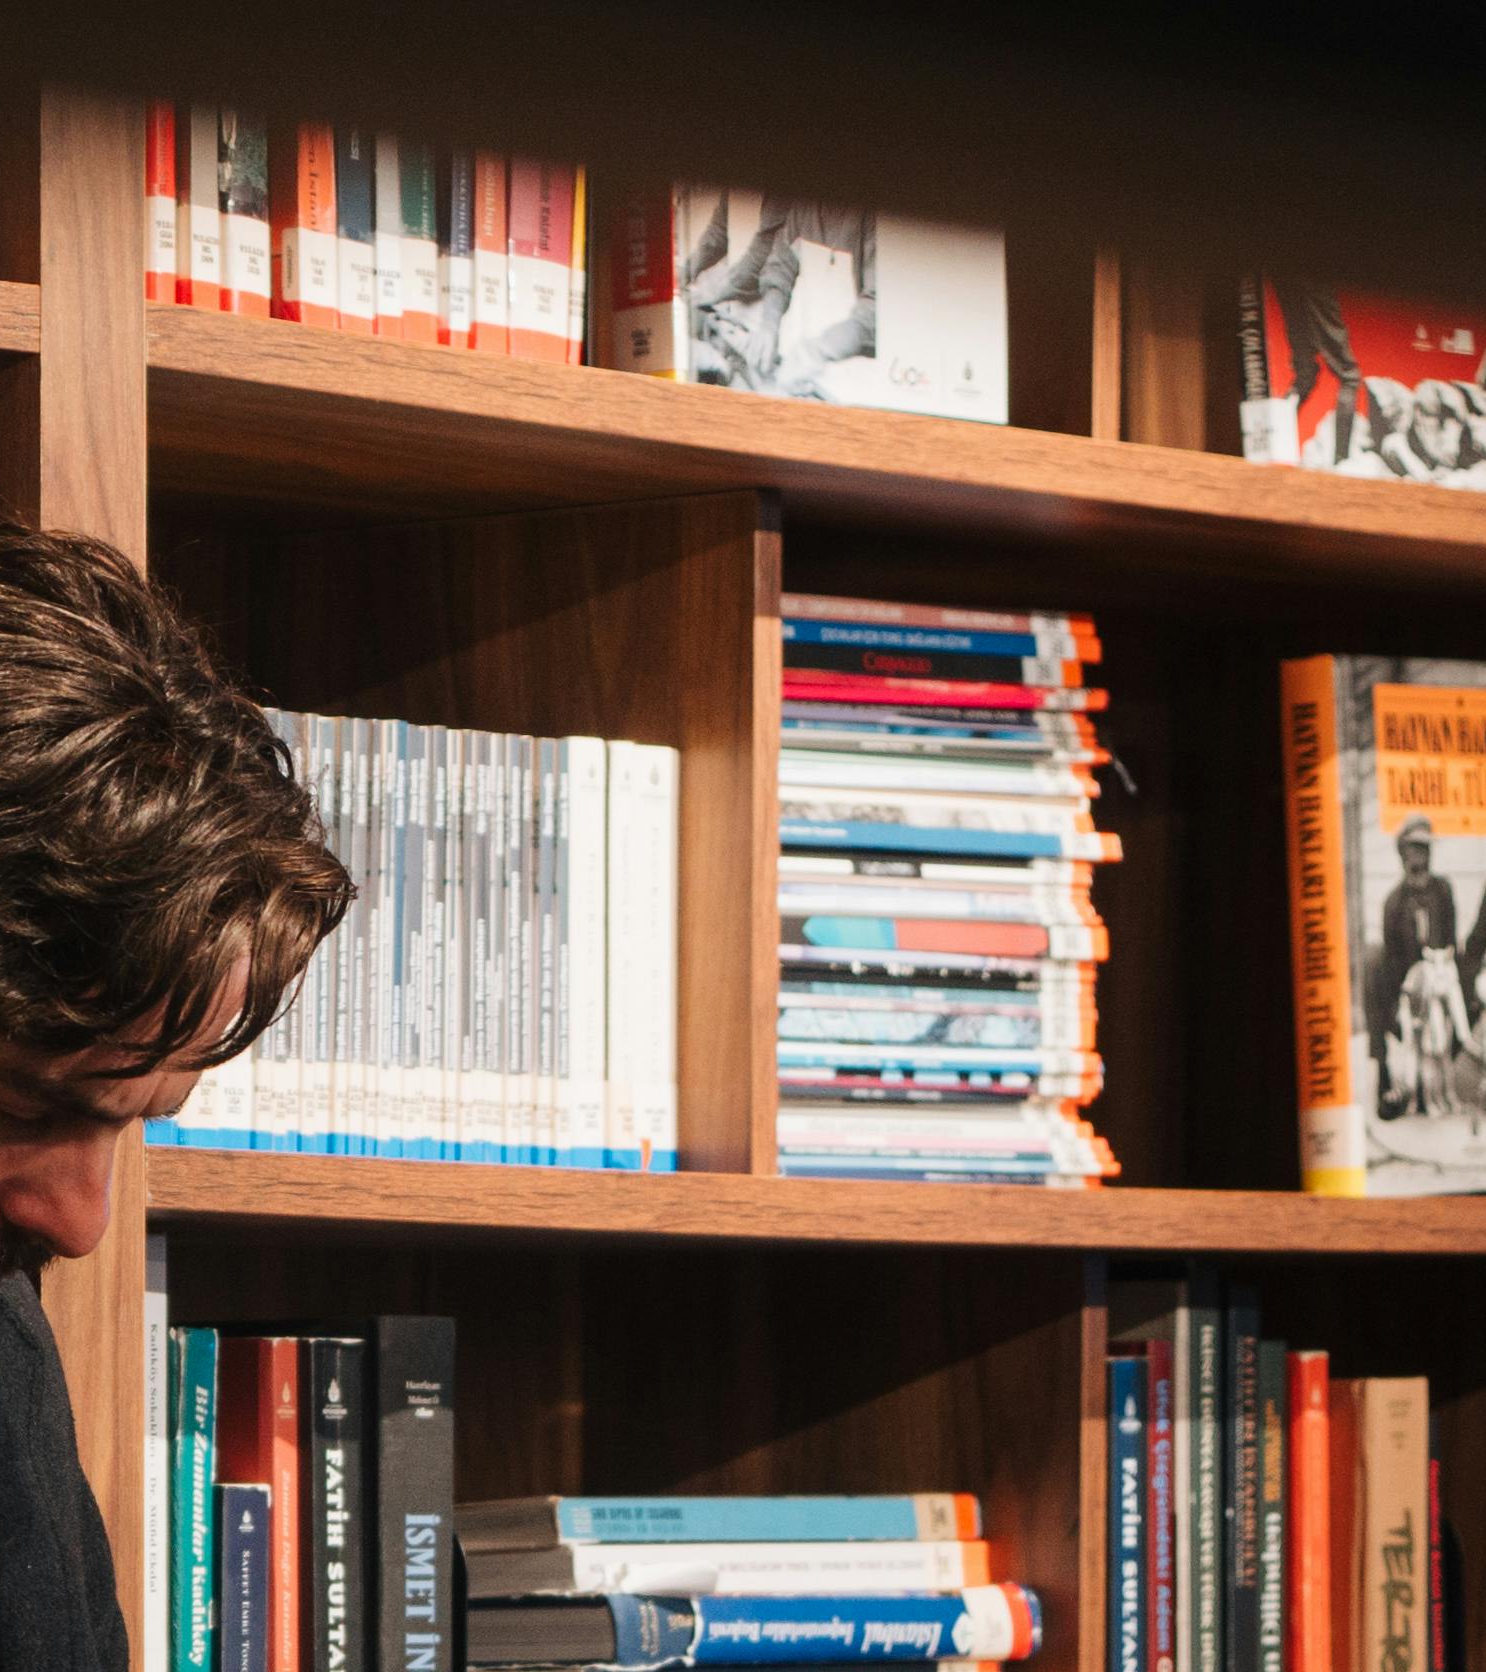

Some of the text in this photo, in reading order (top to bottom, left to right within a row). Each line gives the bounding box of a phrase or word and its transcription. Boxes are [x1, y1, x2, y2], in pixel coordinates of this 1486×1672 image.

[1383, 712, 1451, 753] HAYVAN
[1293, 701, 1326, 901] HAYVAN HAKLARI
[194, 1386, 208, 1425] Bir
[192, 1430, 208, 1562] Zamanlar
[325, 1448, 347, 1547] FATİH
[405, 1513, 439, 1622] İSMET
